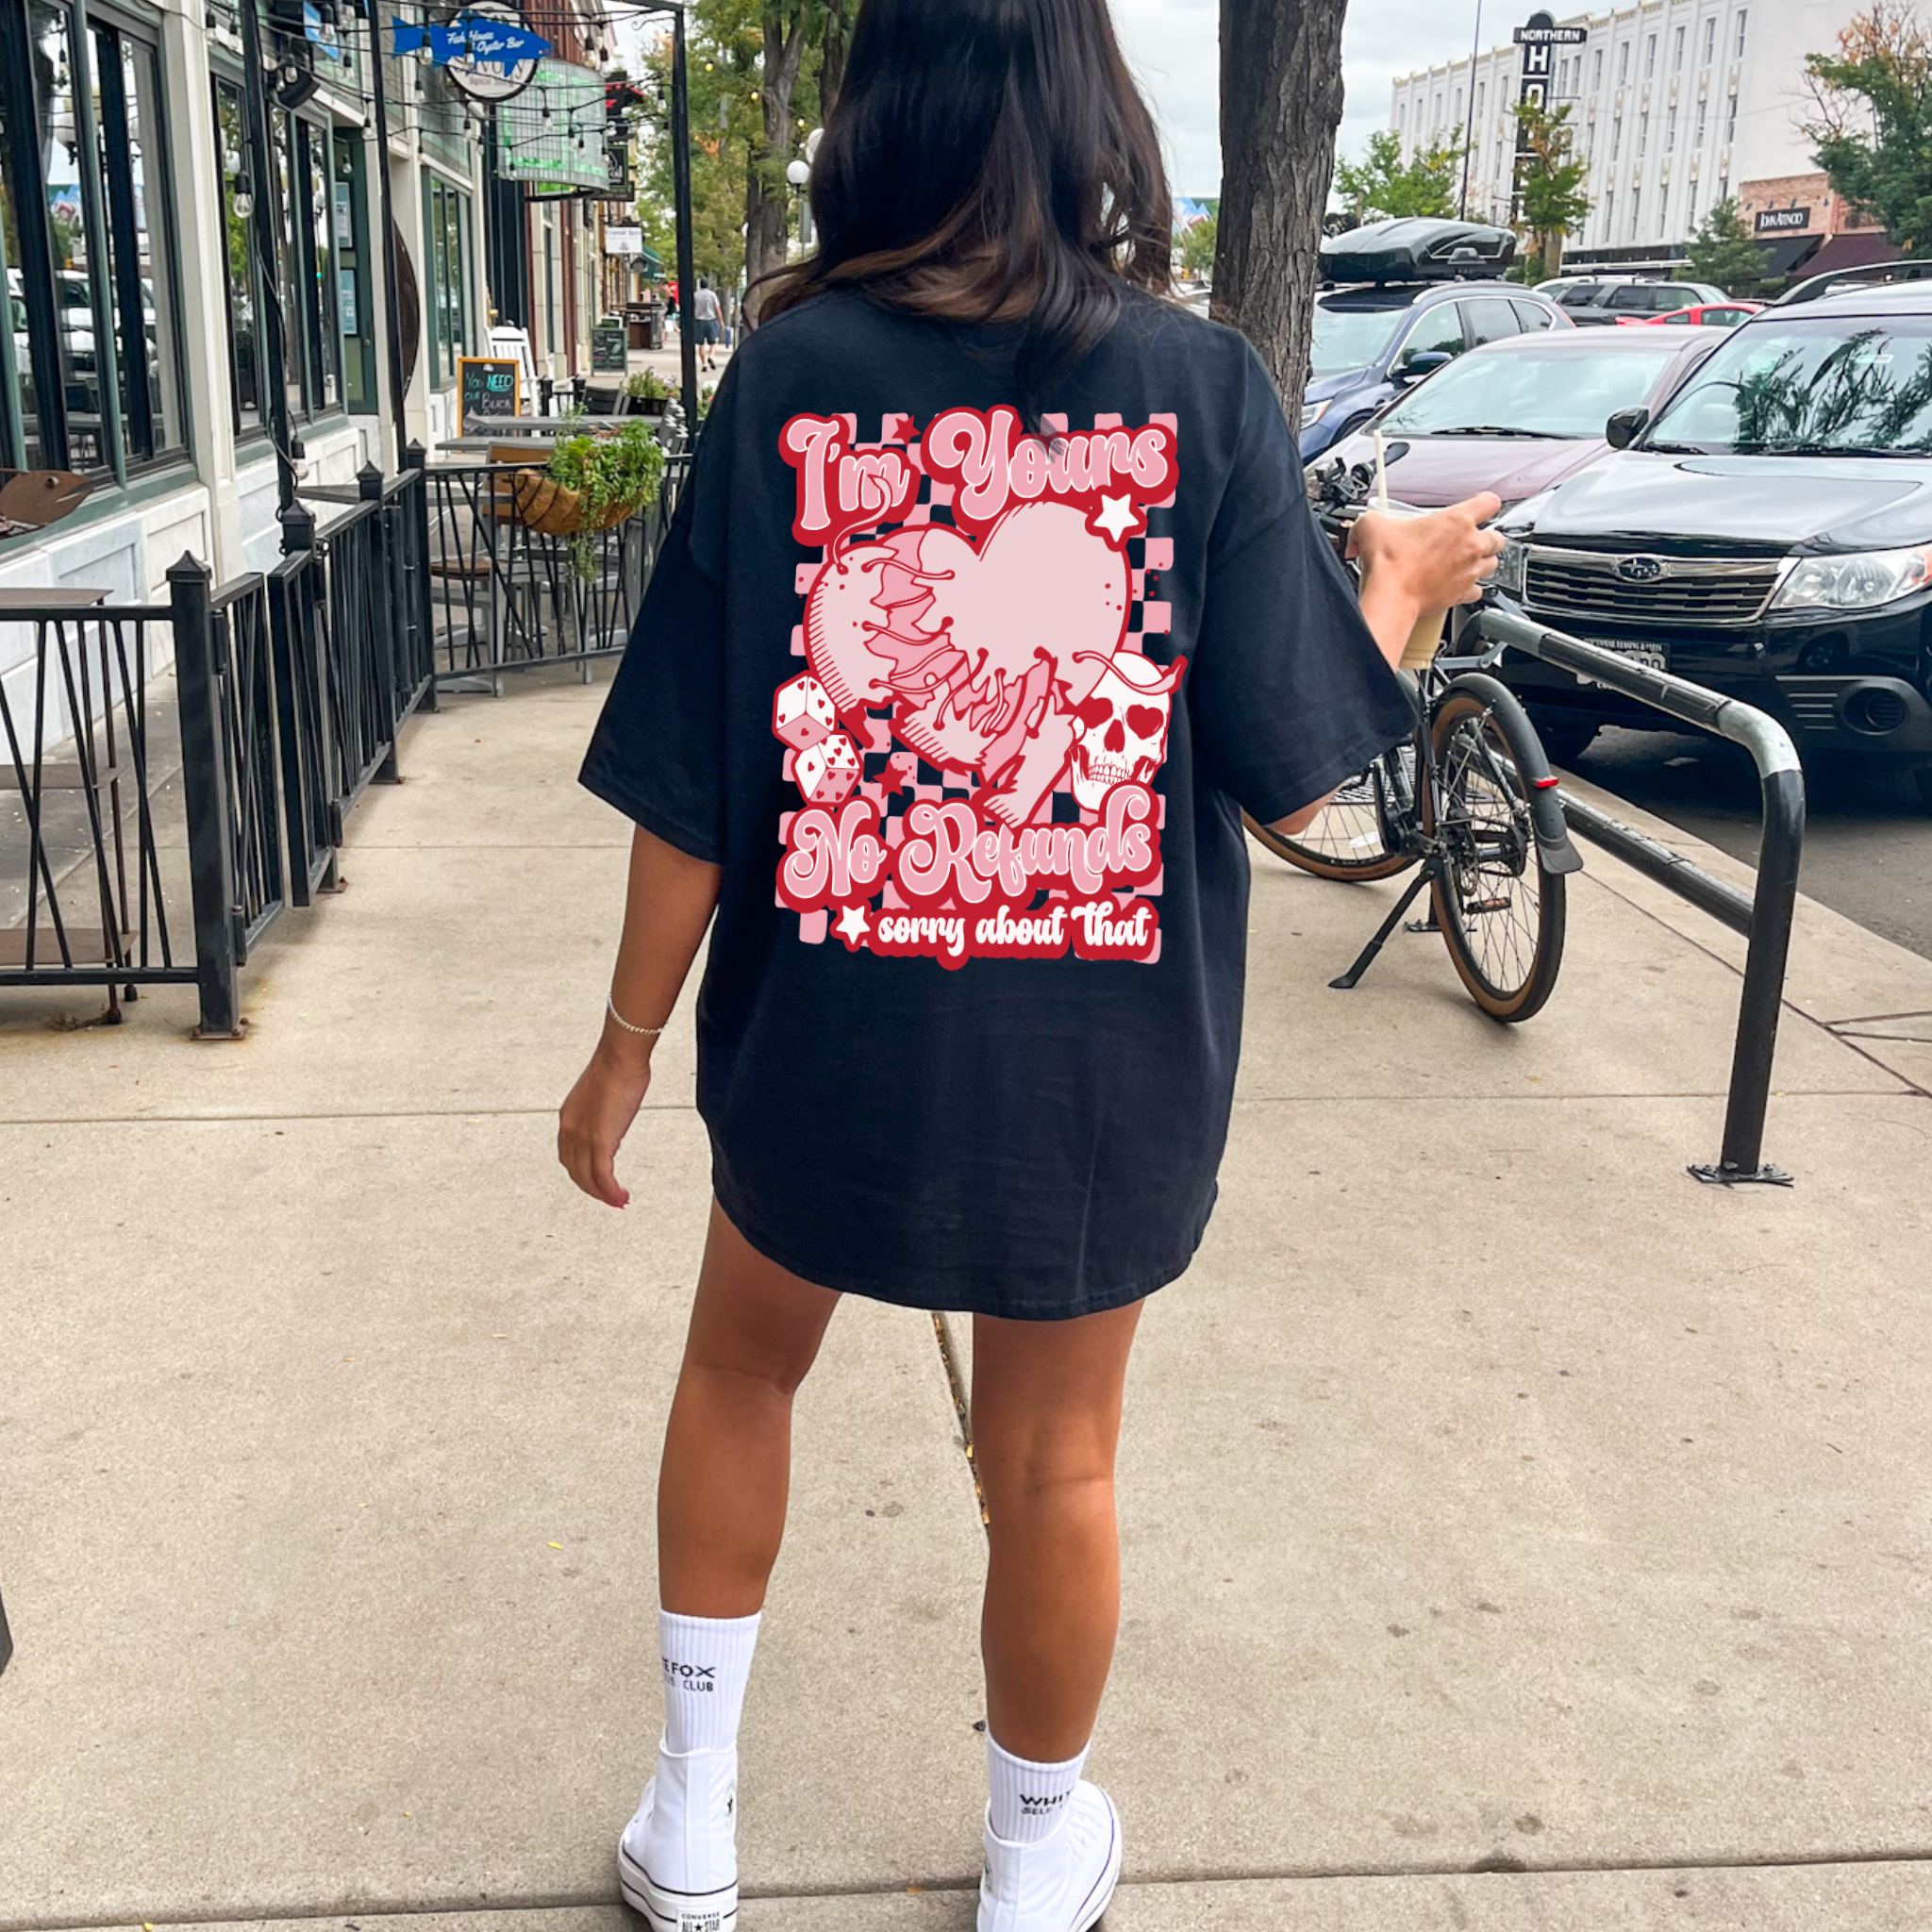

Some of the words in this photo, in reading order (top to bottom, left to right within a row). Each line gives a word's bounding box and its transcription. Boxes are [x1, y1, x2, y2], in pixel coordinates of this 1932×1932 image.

[446, 32, 466, 44] Fish
[1521, 29, 1581, 42] NORTHERN
[476, 42, 505, 55] Oyster
[507, 37, 525, 48] Bar
[487, 374, 514, 390] NEED
[787, 418, 910, 530] I'm
[929, 409, 1168, 520] Yours
[784, 800, 887, 898] No
[899, 785, 1152, 903] Refunds
[878, 915, 965, 957] sorry
[975, 905, 1064, 945] about
[1071, 902, 1152, 945] that
[683, 1680, 714, 1691] CLUB
